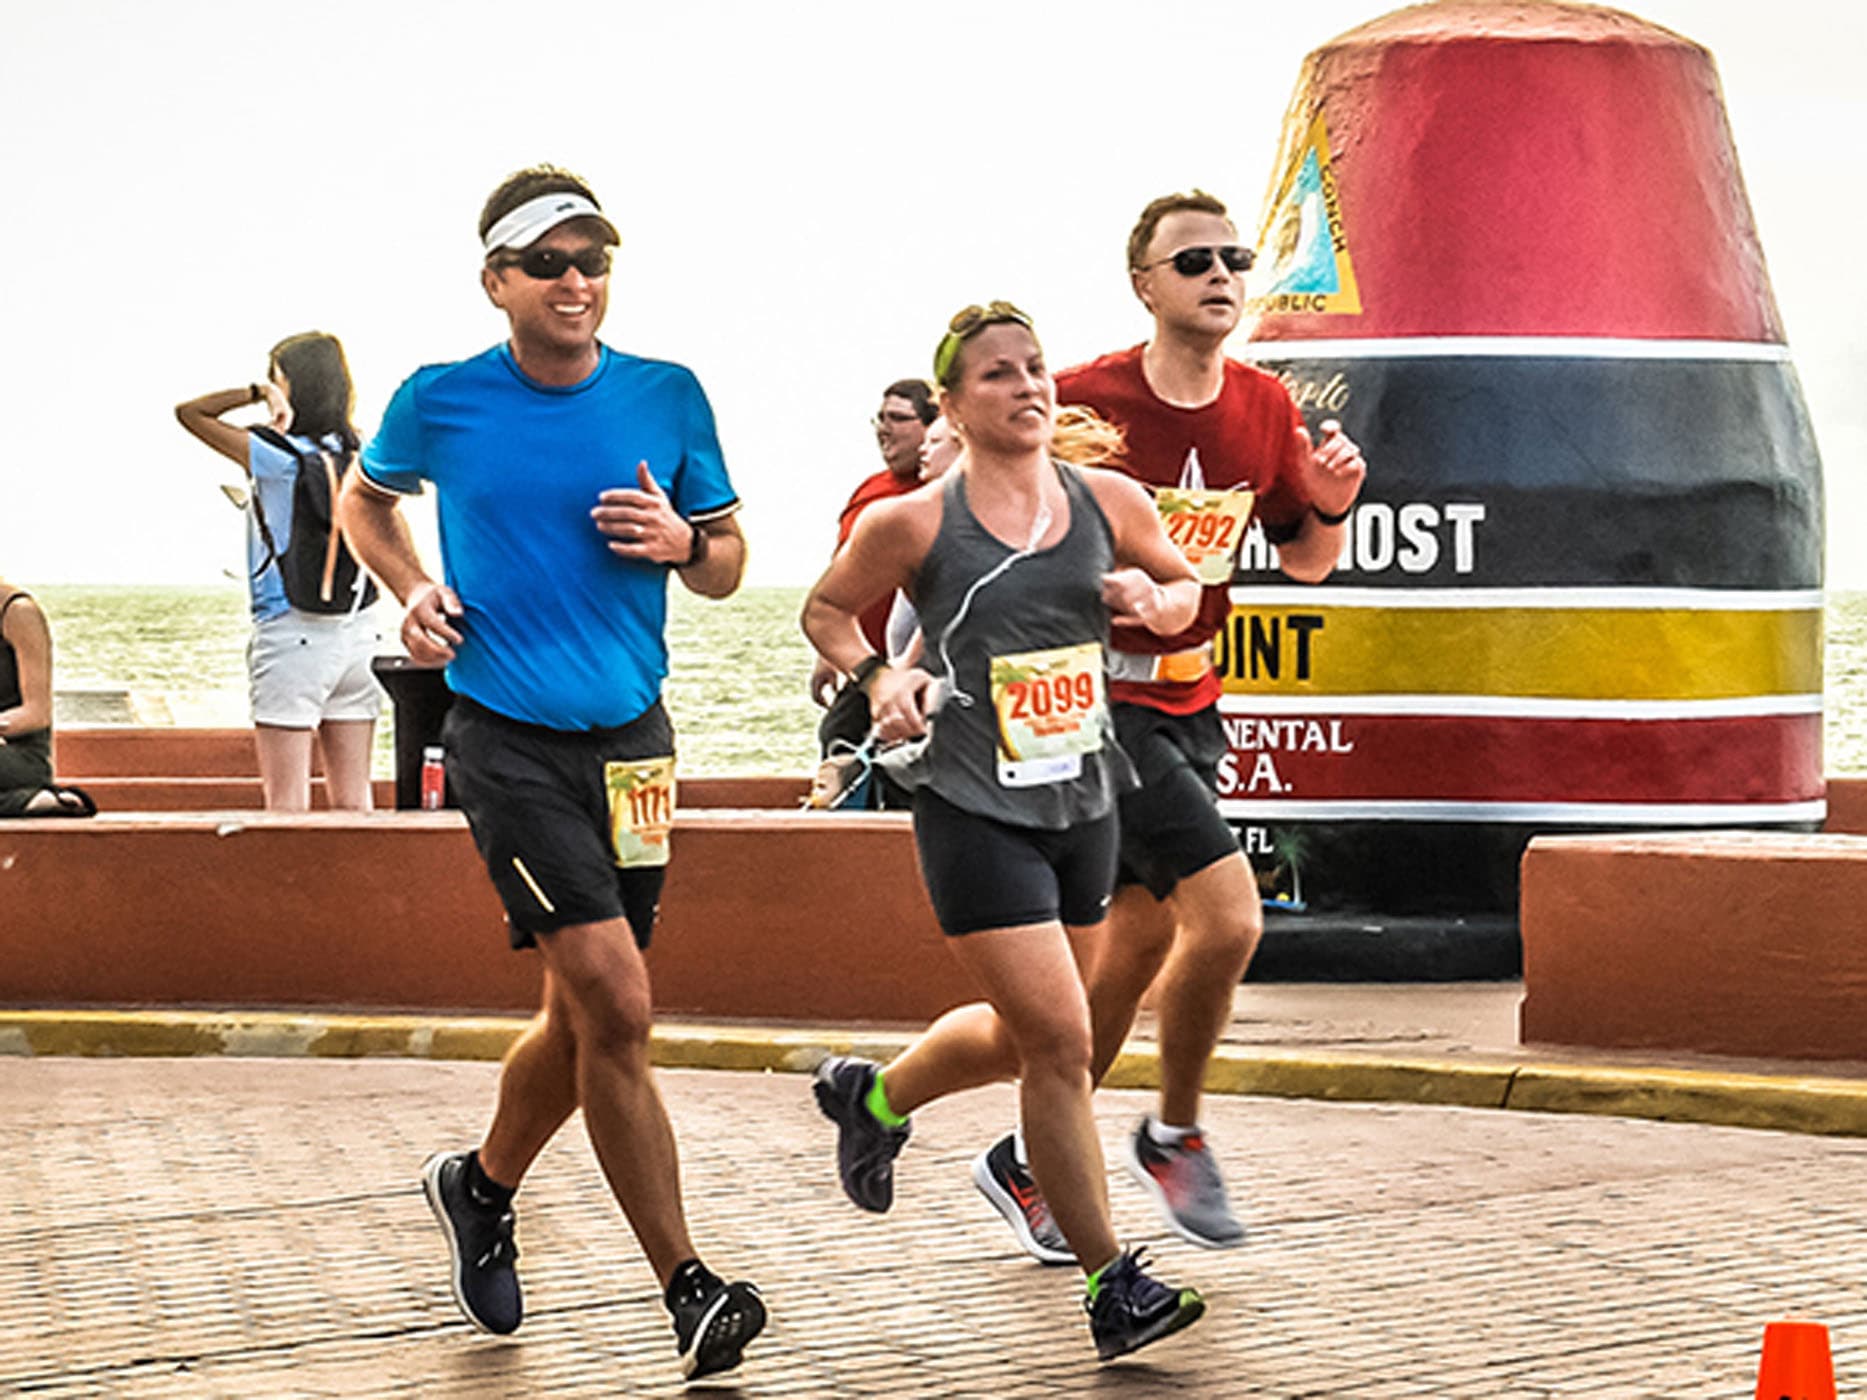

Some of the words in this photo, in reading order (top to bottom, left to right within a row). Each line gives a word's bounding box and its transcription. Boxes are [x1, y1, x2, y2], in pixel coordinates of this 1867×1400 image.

[1320, 165, 1346, 253] CONCH
[1169, 512, 1236, 548] 2792
[1006, 671, 1095, 719] 2099
[1245, 826, 1275, 855] FL
